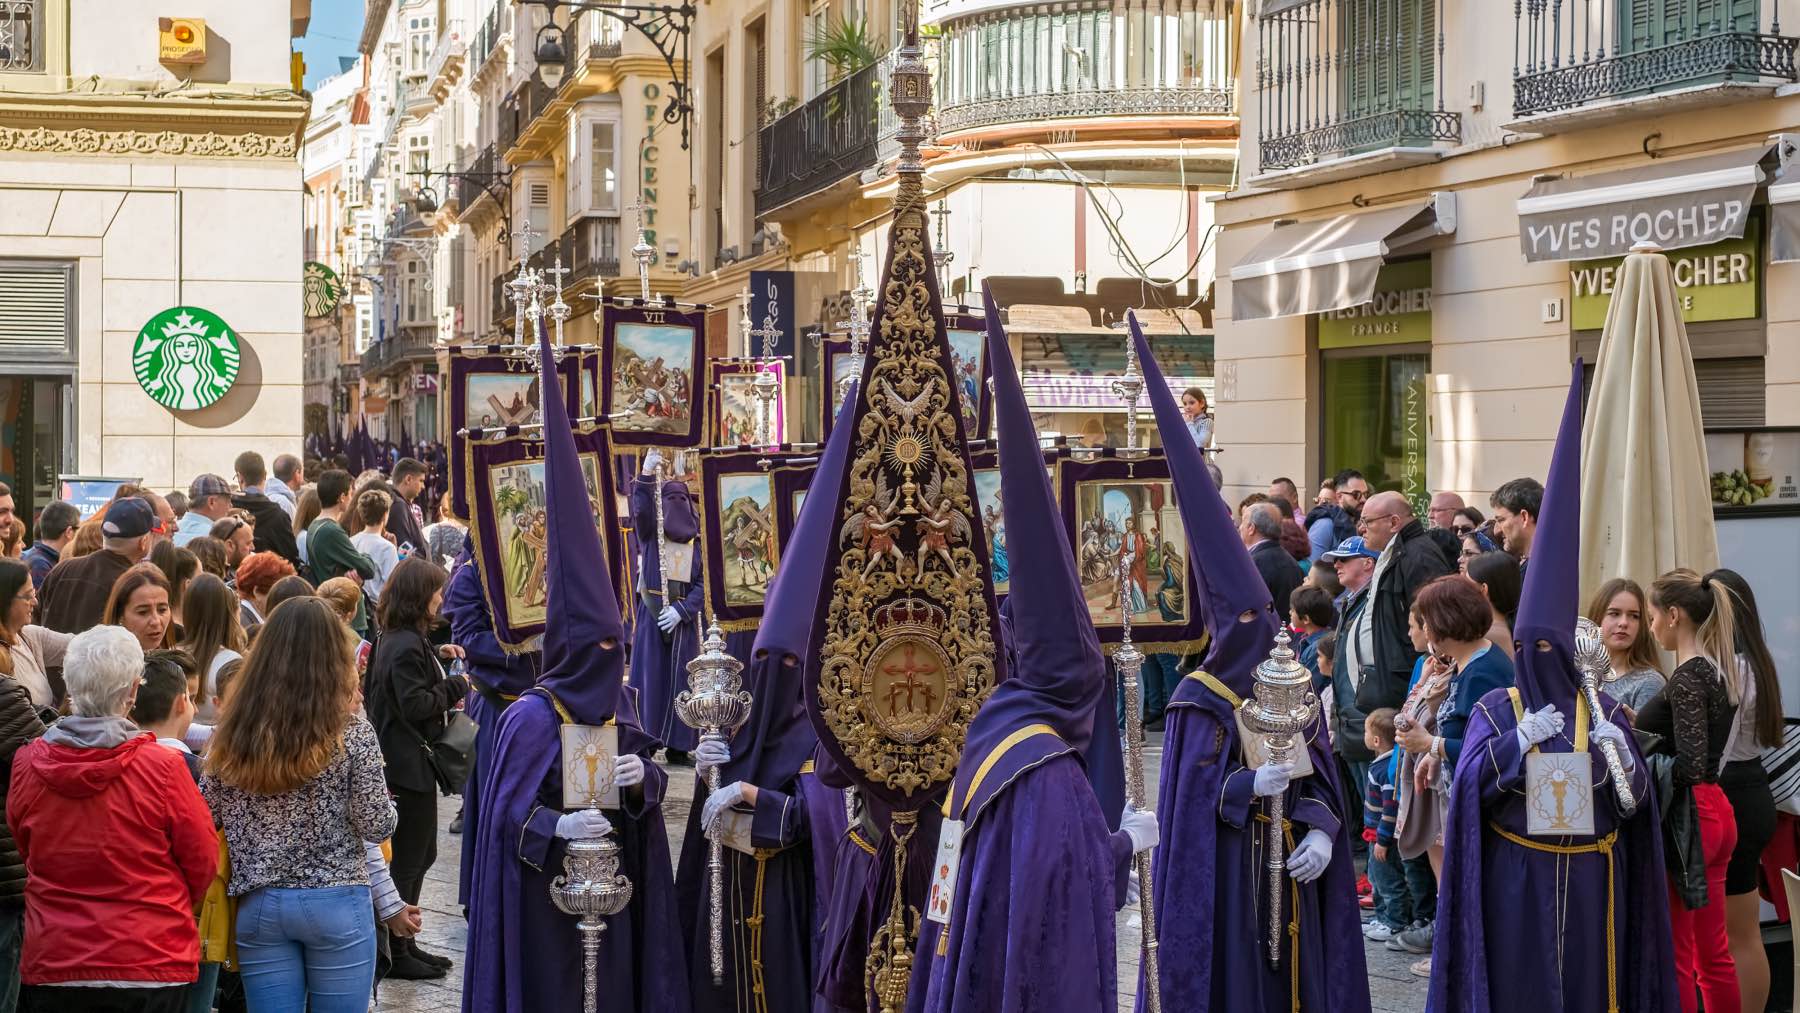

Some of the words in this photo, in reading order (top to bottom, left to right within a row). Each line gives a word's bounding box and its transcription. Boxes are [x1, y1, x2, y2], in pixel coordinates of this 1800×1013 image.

[1528, 217, 1601, 254] YVES
[1611, 199, 1743, 246] ROCHER
[1570, 265, 1622, 297] YVE
[1674, 253, 1748, 288] CHER
[643, 311, 666, 324] VII
[1547, 303, 1556, 317] 10
[1351, 321, 1399, 337] FRANCE
